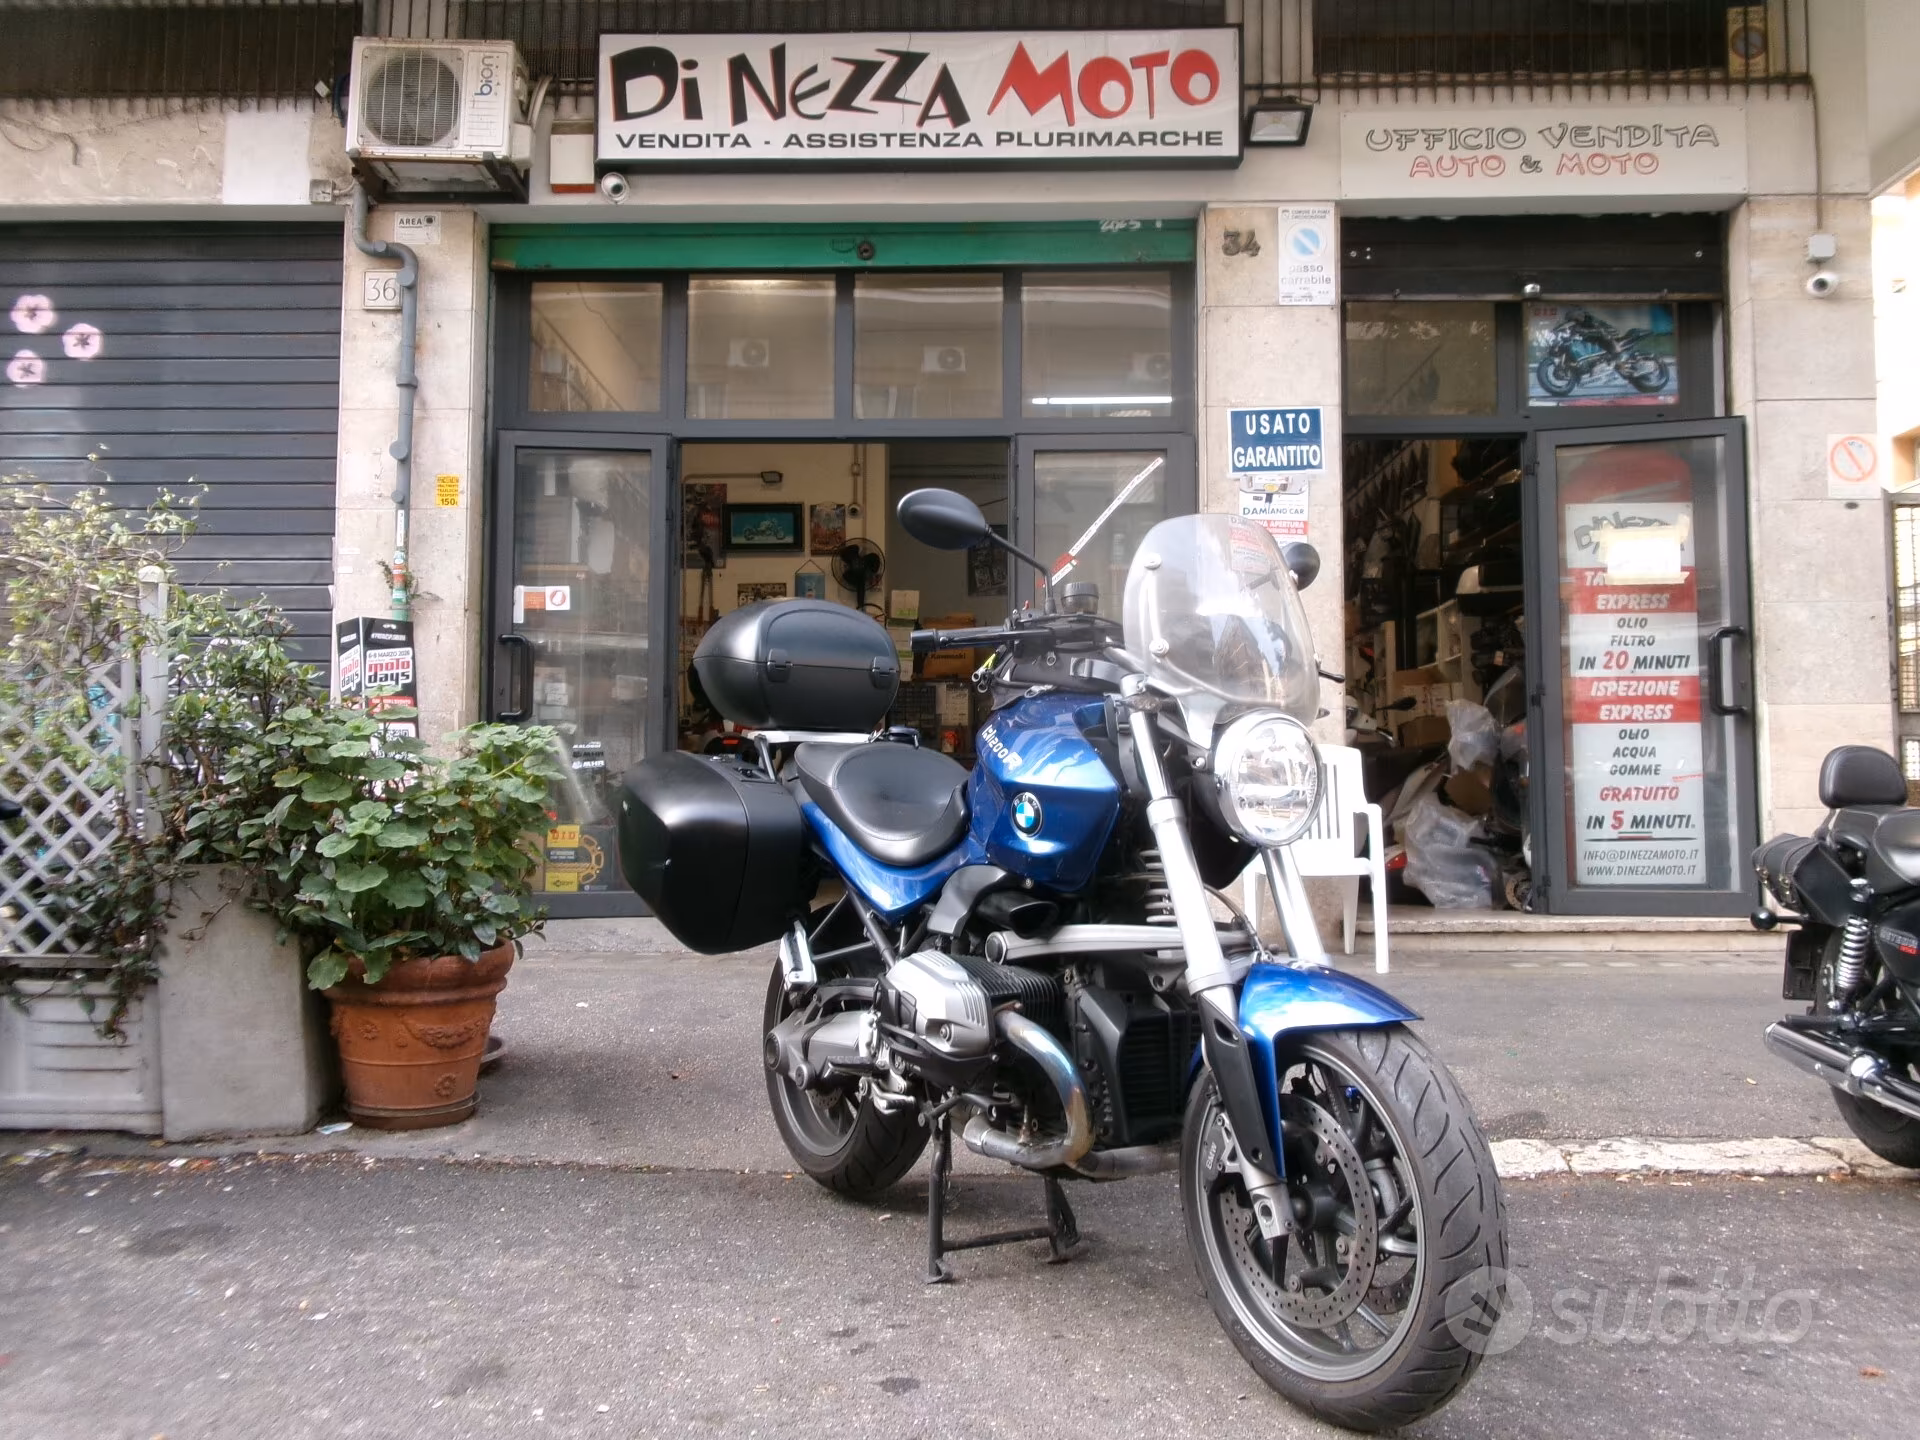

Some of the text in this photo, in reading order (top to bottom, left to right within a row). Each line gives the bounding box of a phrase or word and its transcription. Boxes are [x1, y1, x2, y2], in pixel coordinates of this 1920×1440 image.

[986, 40, 1220, 127] MOTO
[615, 133, 752, 149] VENDITA
[782, 132, 983, 149] ASSISTENZA
[995, 130, 1224, 148] PLURIMARCHE
[1365, 122, 1720, 152] UFFICIO VENDITA
[1408, 152, 1660, 179] AUTO & MOTO
[399, 217, 423, 226] AREA
[367, 277, 397, 301] 36
[1245, 412, 1311, 435] USATO
[1233, 445, 1321, 468] GARANTITO
[1242, 507, 1288, 516] DAMIANO
[1596, 593, 1670, 610] EXPRESS
[1617, 617, 1648, 629] OLIO
[1610, 635, 1655, 647] FILTRO
[1579, 651, 1691, 670] IN 20 MINUTI
[1591, 680, 1681, 697] ISPEZIONE
[1600, 704, 1674, 721] EXPRESS
[1618, 729, 1650, 740] OLIO
[1612, 746, 1657, 759] ACQUA
[1610, 764, 1662, 776] GOMME
[1600, 786, 1680, 802] GRATUITO
[1586, 815, 1605, 830] IN
[1610, 810, 1625, 830] 5
[1583, 848, 1699, 863] INFO@DINEZZAMOTO.IT
[1586, 864, 1697, 877] WWW.DINEZZAMOTO.IT
